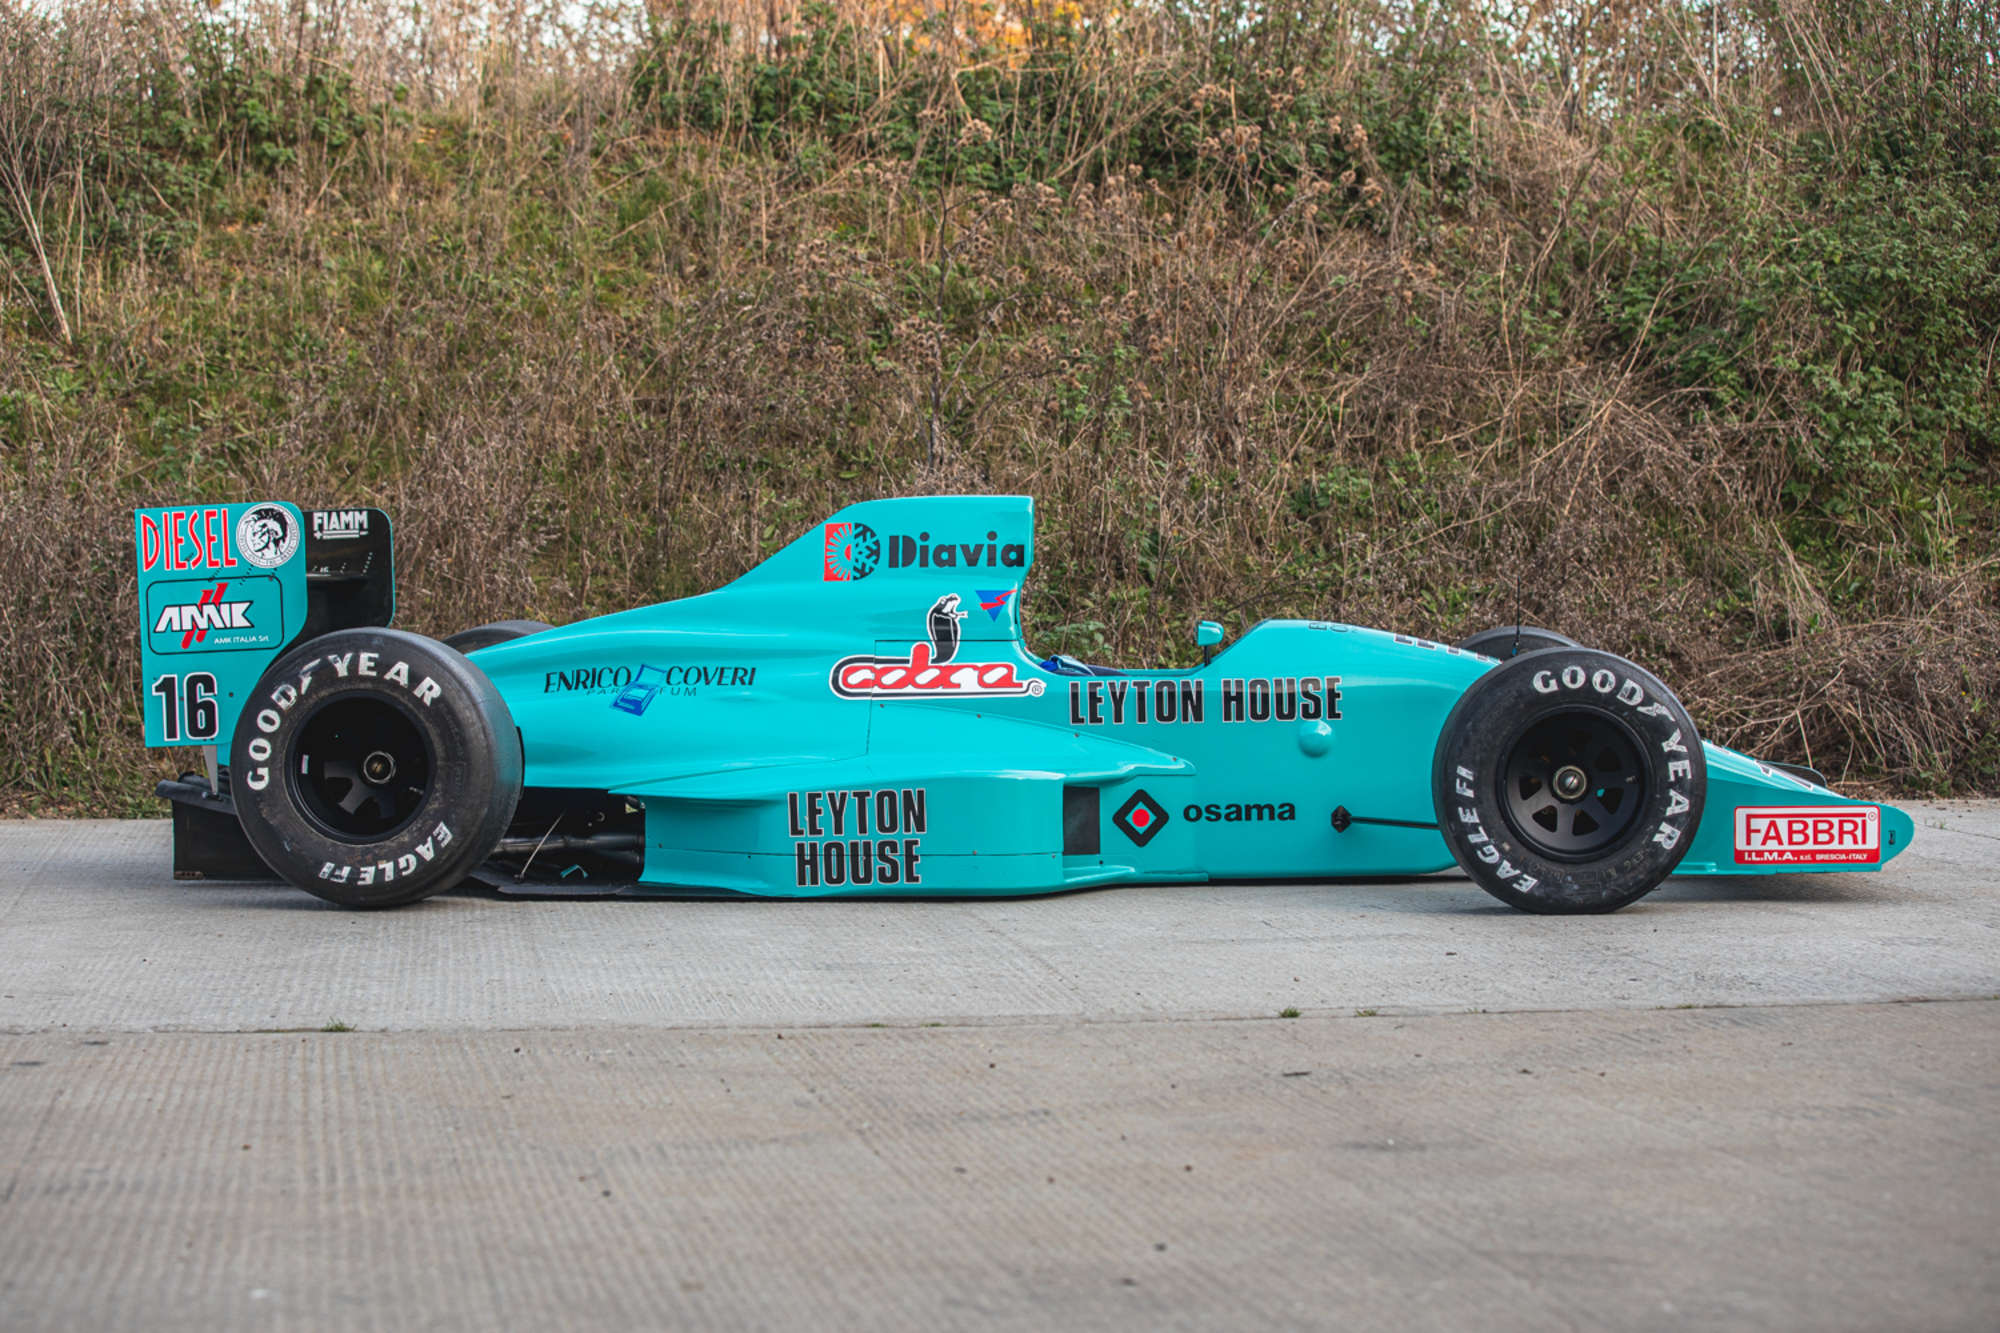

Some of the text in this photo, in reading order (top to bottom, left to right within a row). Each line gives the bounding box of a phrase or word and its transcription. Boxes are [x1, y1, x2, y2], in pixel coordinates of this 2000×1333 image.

[141, 508, 237, 572] DIESEL
[313, 510, 369, 531] FIAMM
[888, 531, 1025, 569] Diavia
[544, 665, 757, 694] ENRICO COVERI
[841, 643, 1024, 690] cobra
[151, 671, 219, 742] 16
[1069, 676, 1343, 725] LEYTON HOUSE
[1532, 665, 1692, 850] GOODYEAR
[787, 788, 928, 838] LEYTON
[1182, 801, 1297, 824] osama
[1745, 812, 1867, 846] FABBRI
[356, 821, 453, 886] EAGLE
[795, 838, 922, 888] HOUSE
[1457, 806, 1538, 893] EAGLE
